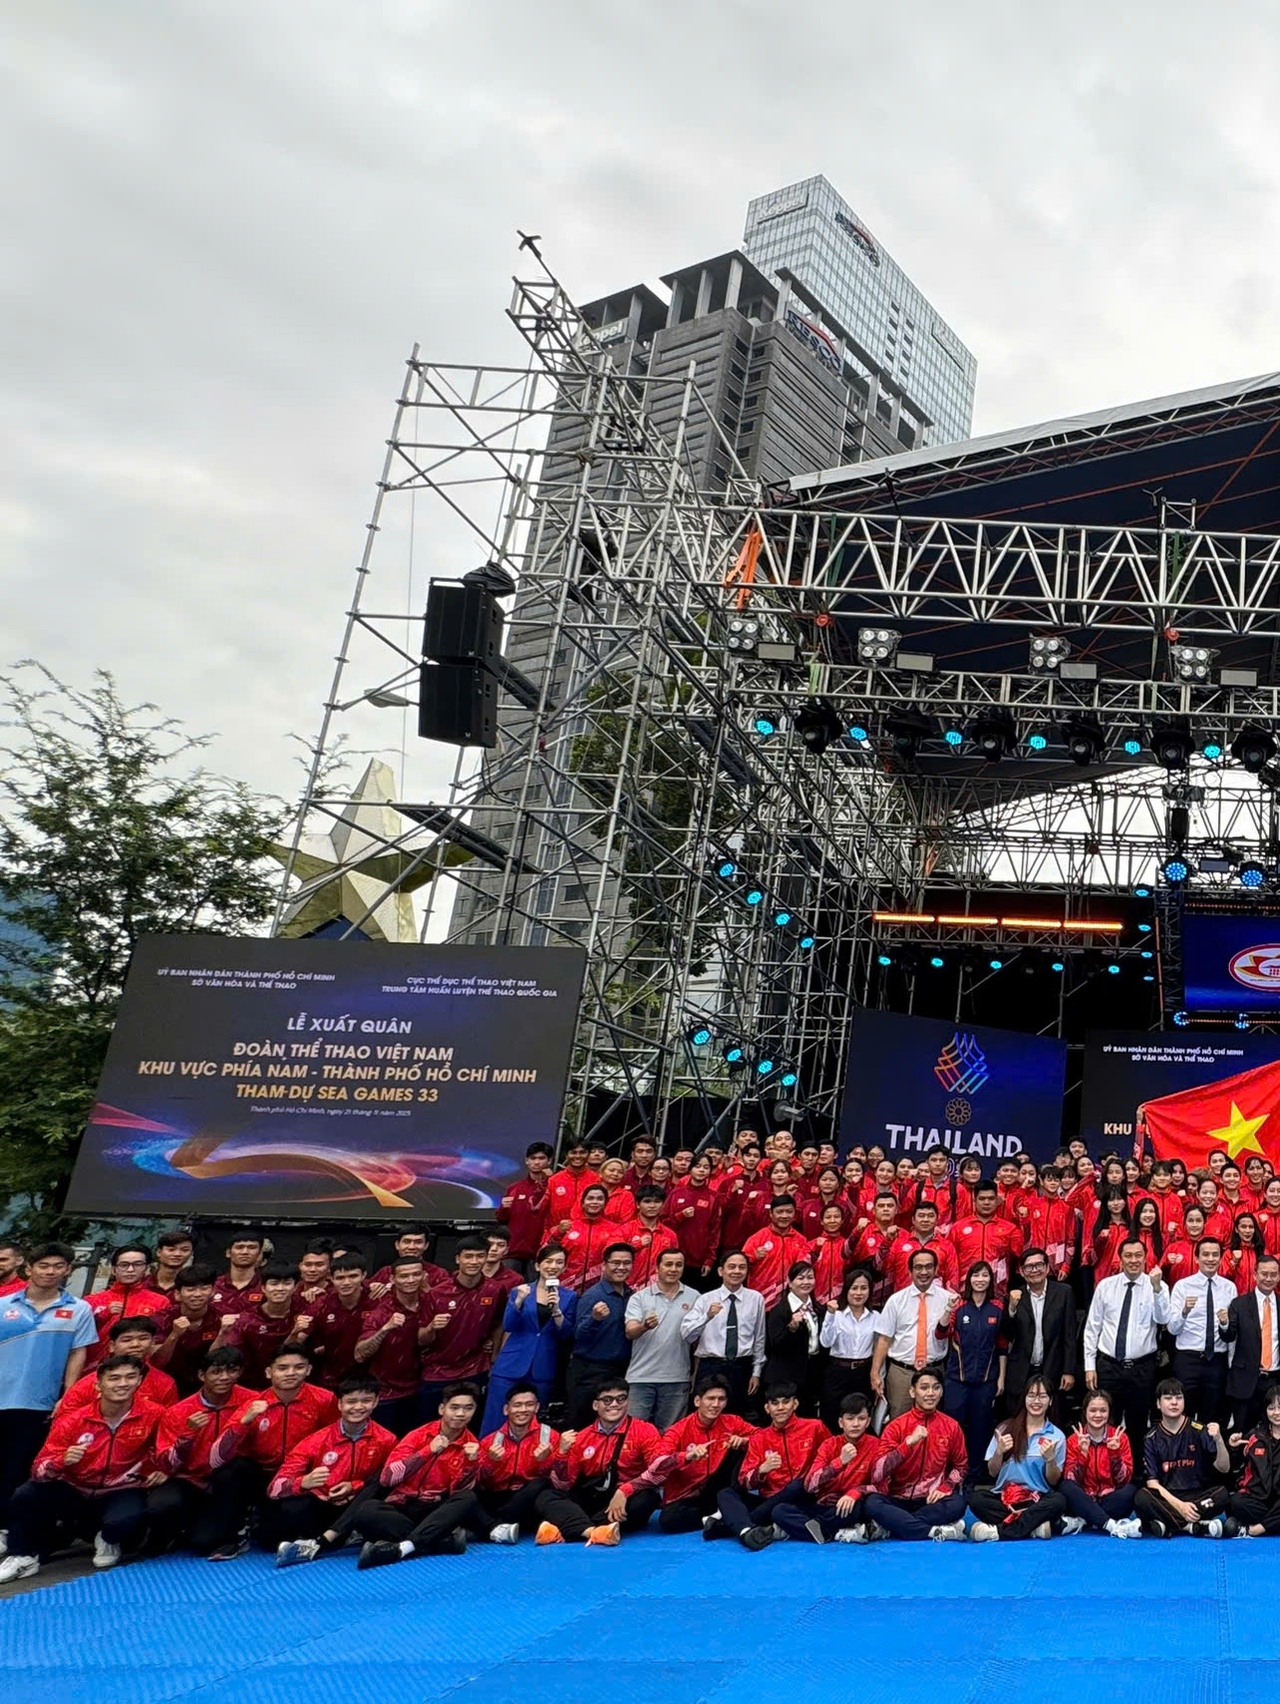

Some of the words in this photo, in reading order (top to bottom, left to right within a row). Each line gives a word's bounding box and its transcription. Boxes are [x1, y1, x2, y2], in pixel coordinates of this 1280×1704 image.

[287, 1012, 307, 1031] LỄ
[309, 1014, 357, 1032] XUẤT
[361, 1018, 412, 1034] QUÂN
[233, 1040, 285, 1057] ĐOÀN
[290, 1038, 323, 1058] THỂ
[324, 1045, 371, 1059] THAO
[376, 1043, 410, 1063] VIỆT
[413, 1048, 453, 1061] NAM
[139, 1061, 175, 1075] KHU
[181, 1060, 218, 1079] VỰC
[221, 1060, 262, 1077] PHÍA
[267, 1064, 308, 1078] NAM
[322, 1063, 380, 1080] THÀNH
[384, 1062, 423, 1081] PHỐ
[426, 1062, 452, 1082] HỒ
[457, 1065, 490, 1082] CHÍ
[492, 1069, 537, 1083] MINH
[318, 1086, 348, 1100] SEA
[354, 1087, 413, 1101] GAMES
[418, 1089, 439, 1102] 33
[1104, 1123, 1132, 1135] KHU
[885, 1123, 1023, 1158] THAILAND
